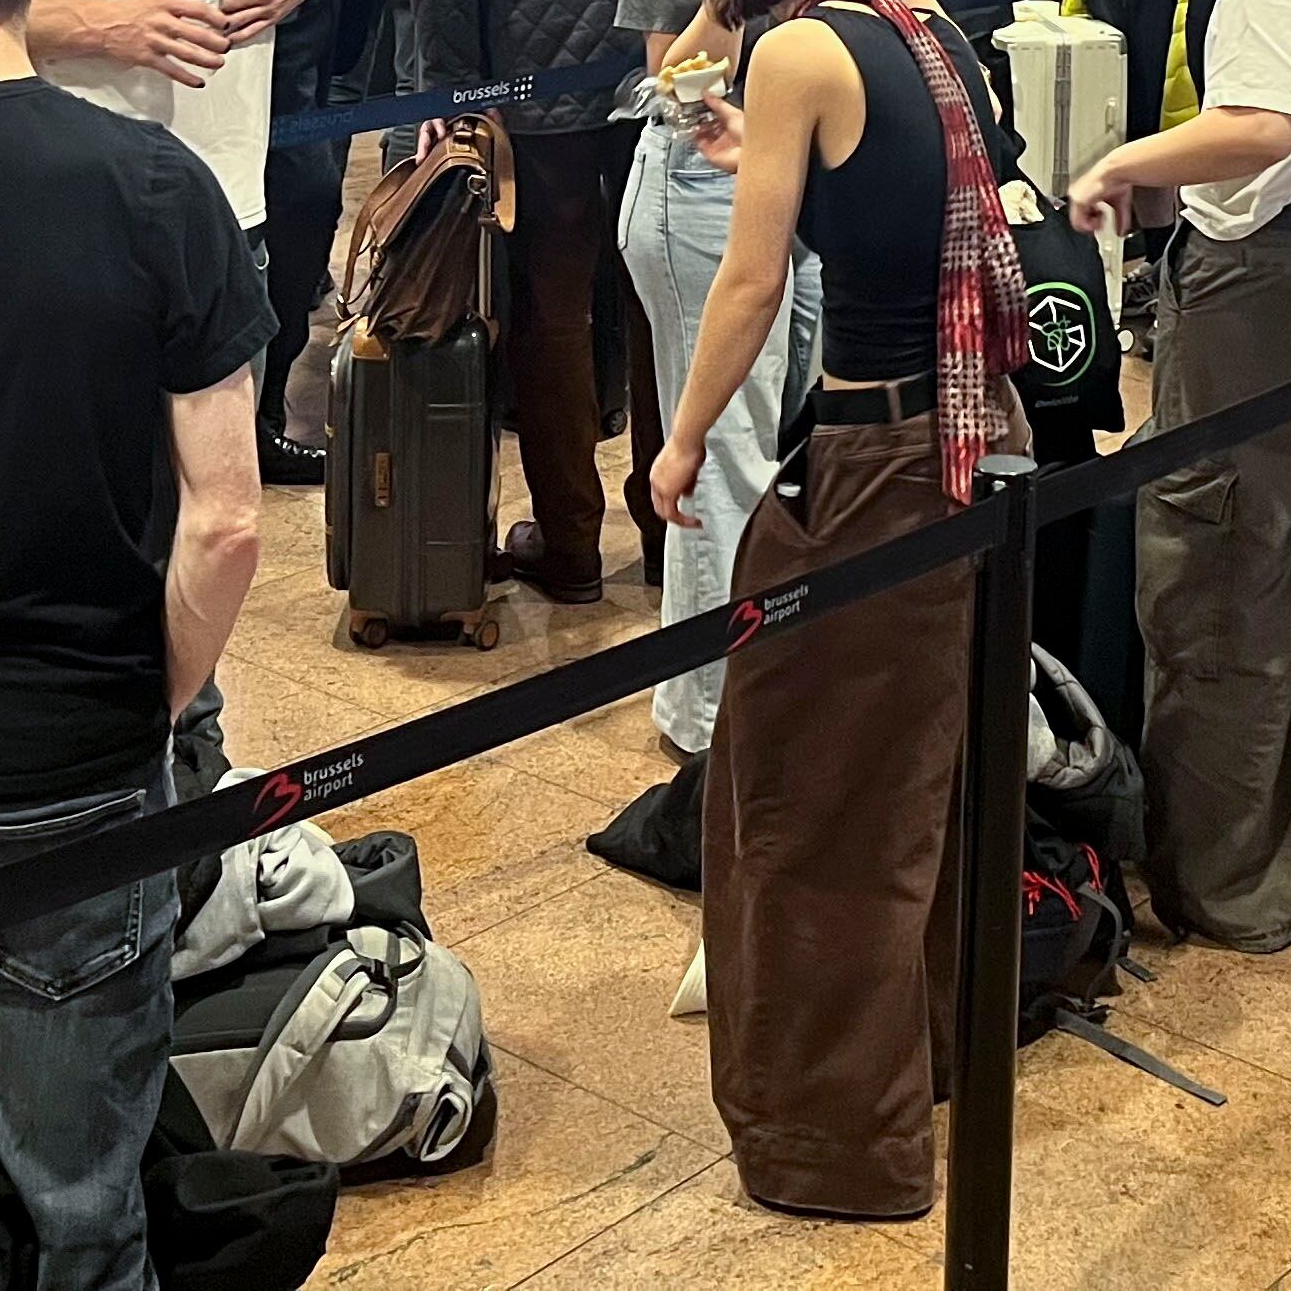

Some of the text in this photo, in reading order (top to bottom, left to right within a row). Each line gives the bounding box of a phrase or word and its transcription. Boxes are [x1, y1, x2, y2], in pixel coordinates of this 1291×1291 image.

[452, 80, 510, 104] brussels
[763, 584, 809, 611] brussels
[763, 600, 801, 625] airport
[303, 752, 364, 785] brussels
[303, 772, 353, 801] airport
